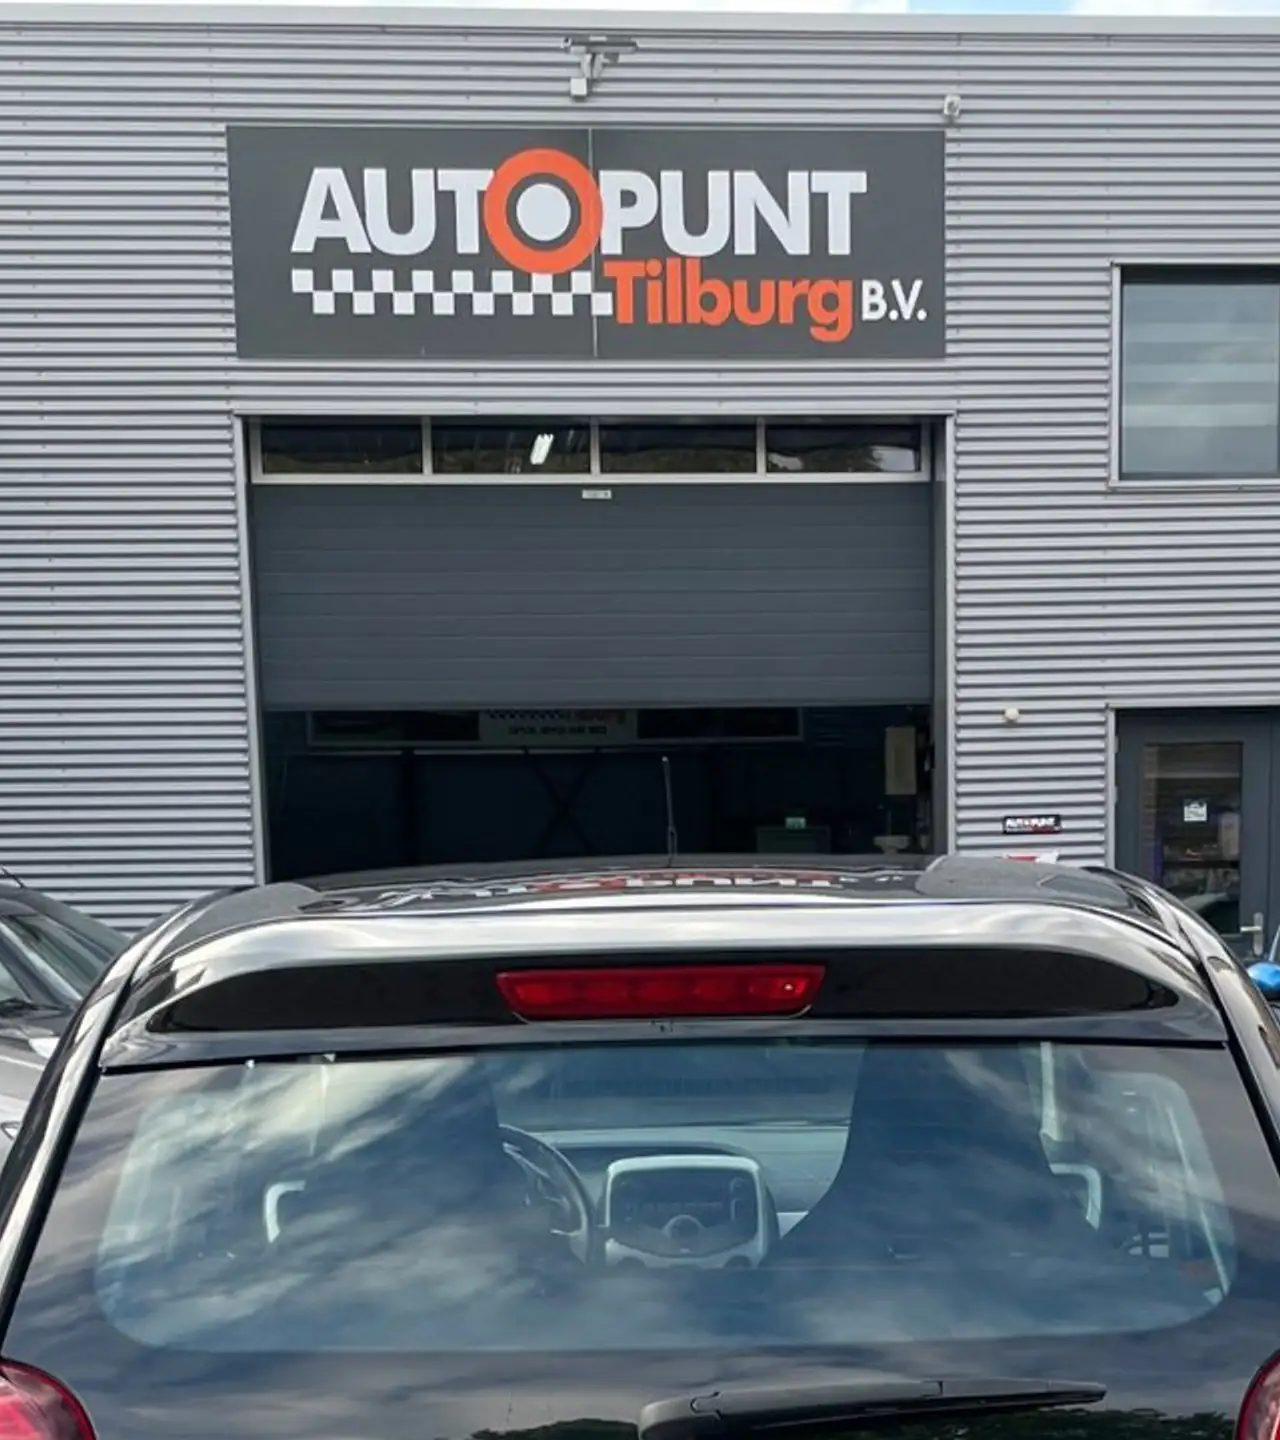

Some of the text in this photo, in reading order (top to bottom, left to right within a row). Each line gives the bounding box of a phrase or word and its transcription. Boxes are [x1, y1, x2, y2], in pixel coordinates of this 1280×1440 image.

[291, 148, 867, 276] AUTOPUNT
[603, 257, 927, 342] Tilburg B.V.
